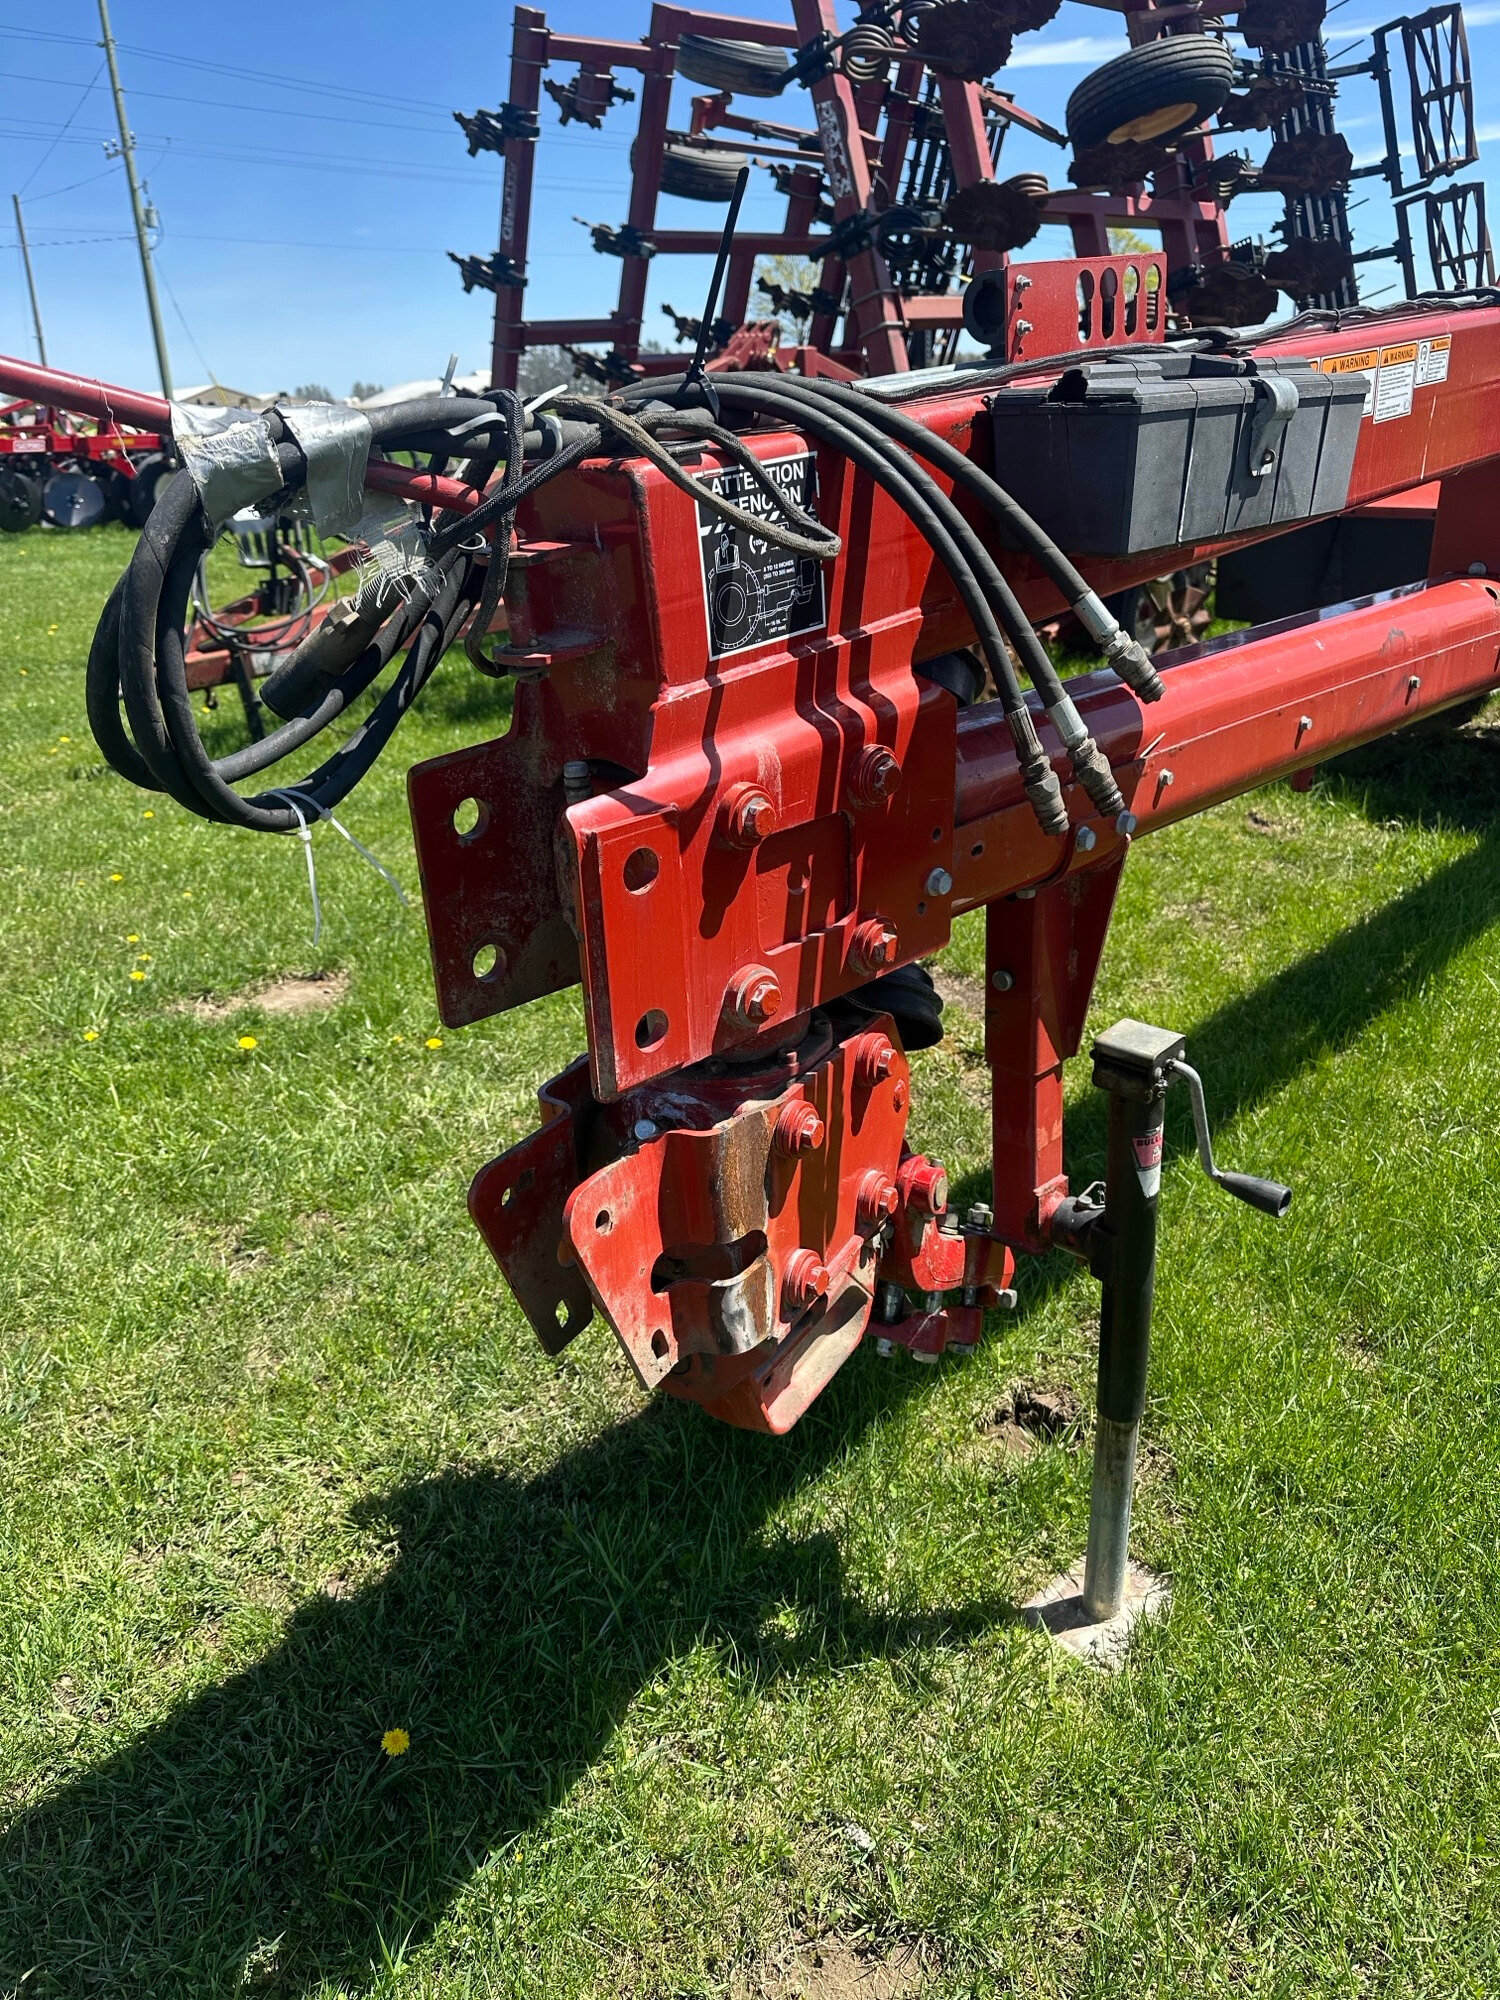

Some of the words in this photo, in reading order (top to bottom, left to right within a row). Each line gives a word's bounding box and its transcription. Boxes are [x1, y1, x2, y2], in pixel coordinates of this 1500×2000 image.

[1389, 348, 1414, 361] WARNING
[1339, 355, 1370, 371] WARNING
[711, 461, 804, 495] ATTETION
